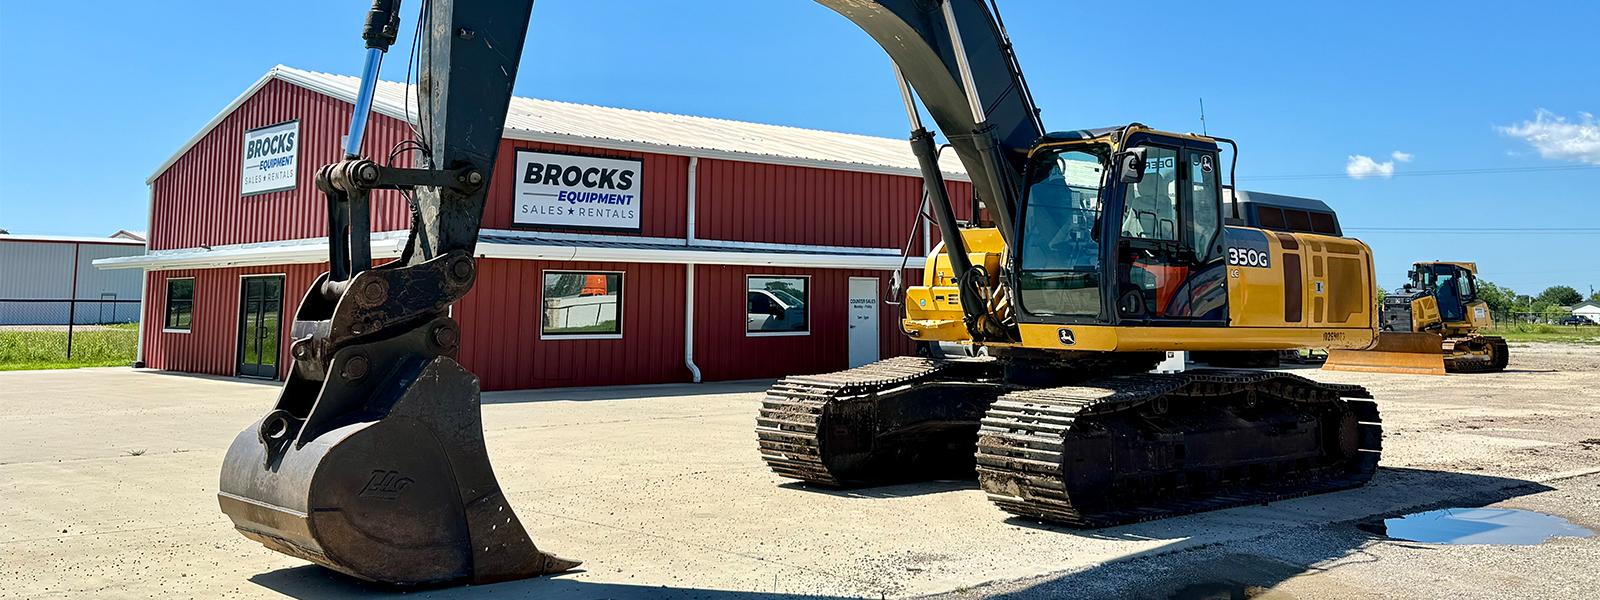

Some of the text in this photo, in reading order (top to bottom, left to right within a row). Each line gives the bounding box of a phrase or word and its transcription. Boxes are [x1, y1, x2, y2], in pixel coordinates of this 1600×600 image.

[246, 131, 295, 160] BROCKS
[259, 155, 294, 171] EQUIPMENT
[245, 169, 294, 185] SALES RENTALS
[523, 162, 635, 190] BROCKS
[558, 190, 634, 205] EQUIPMENT
[522, 204, 634, 219] SALES RENTALS
[1228, 247, 1268, 267] 350G
[1230, 269, 1239, 278] LC
